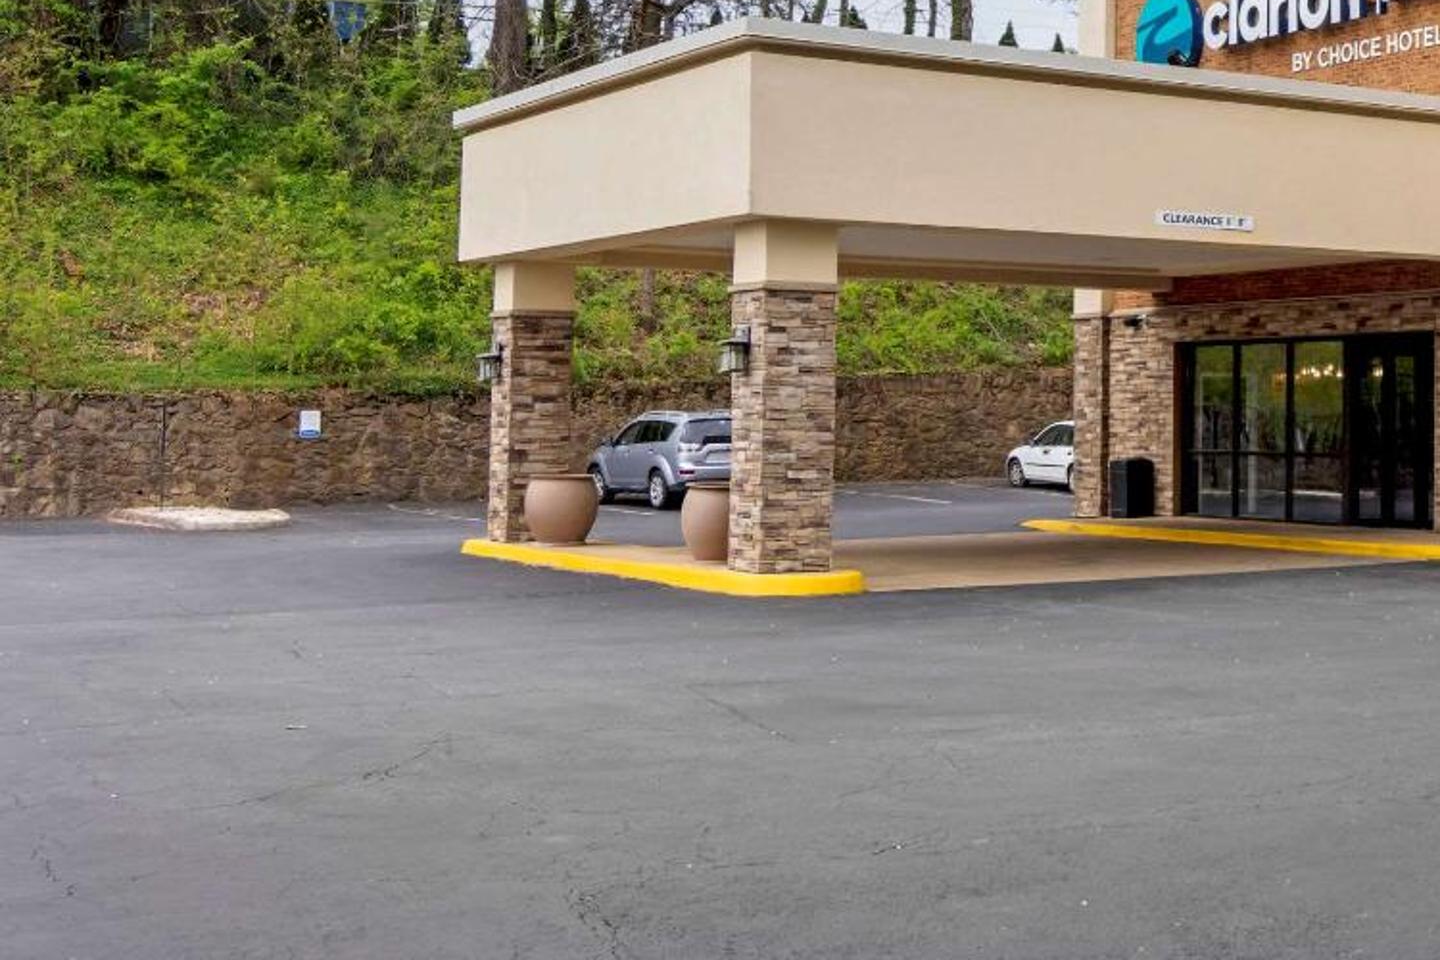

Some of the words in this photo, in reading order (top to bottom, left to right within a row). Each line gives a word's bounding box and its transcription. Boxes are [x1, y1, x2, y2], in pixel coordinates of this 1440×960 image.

[1291, 51, 1313, 73] BY
[1317, 36, 1383, 68] CHOICE
[1162, 212, 1224, 227] CLEARANCE
